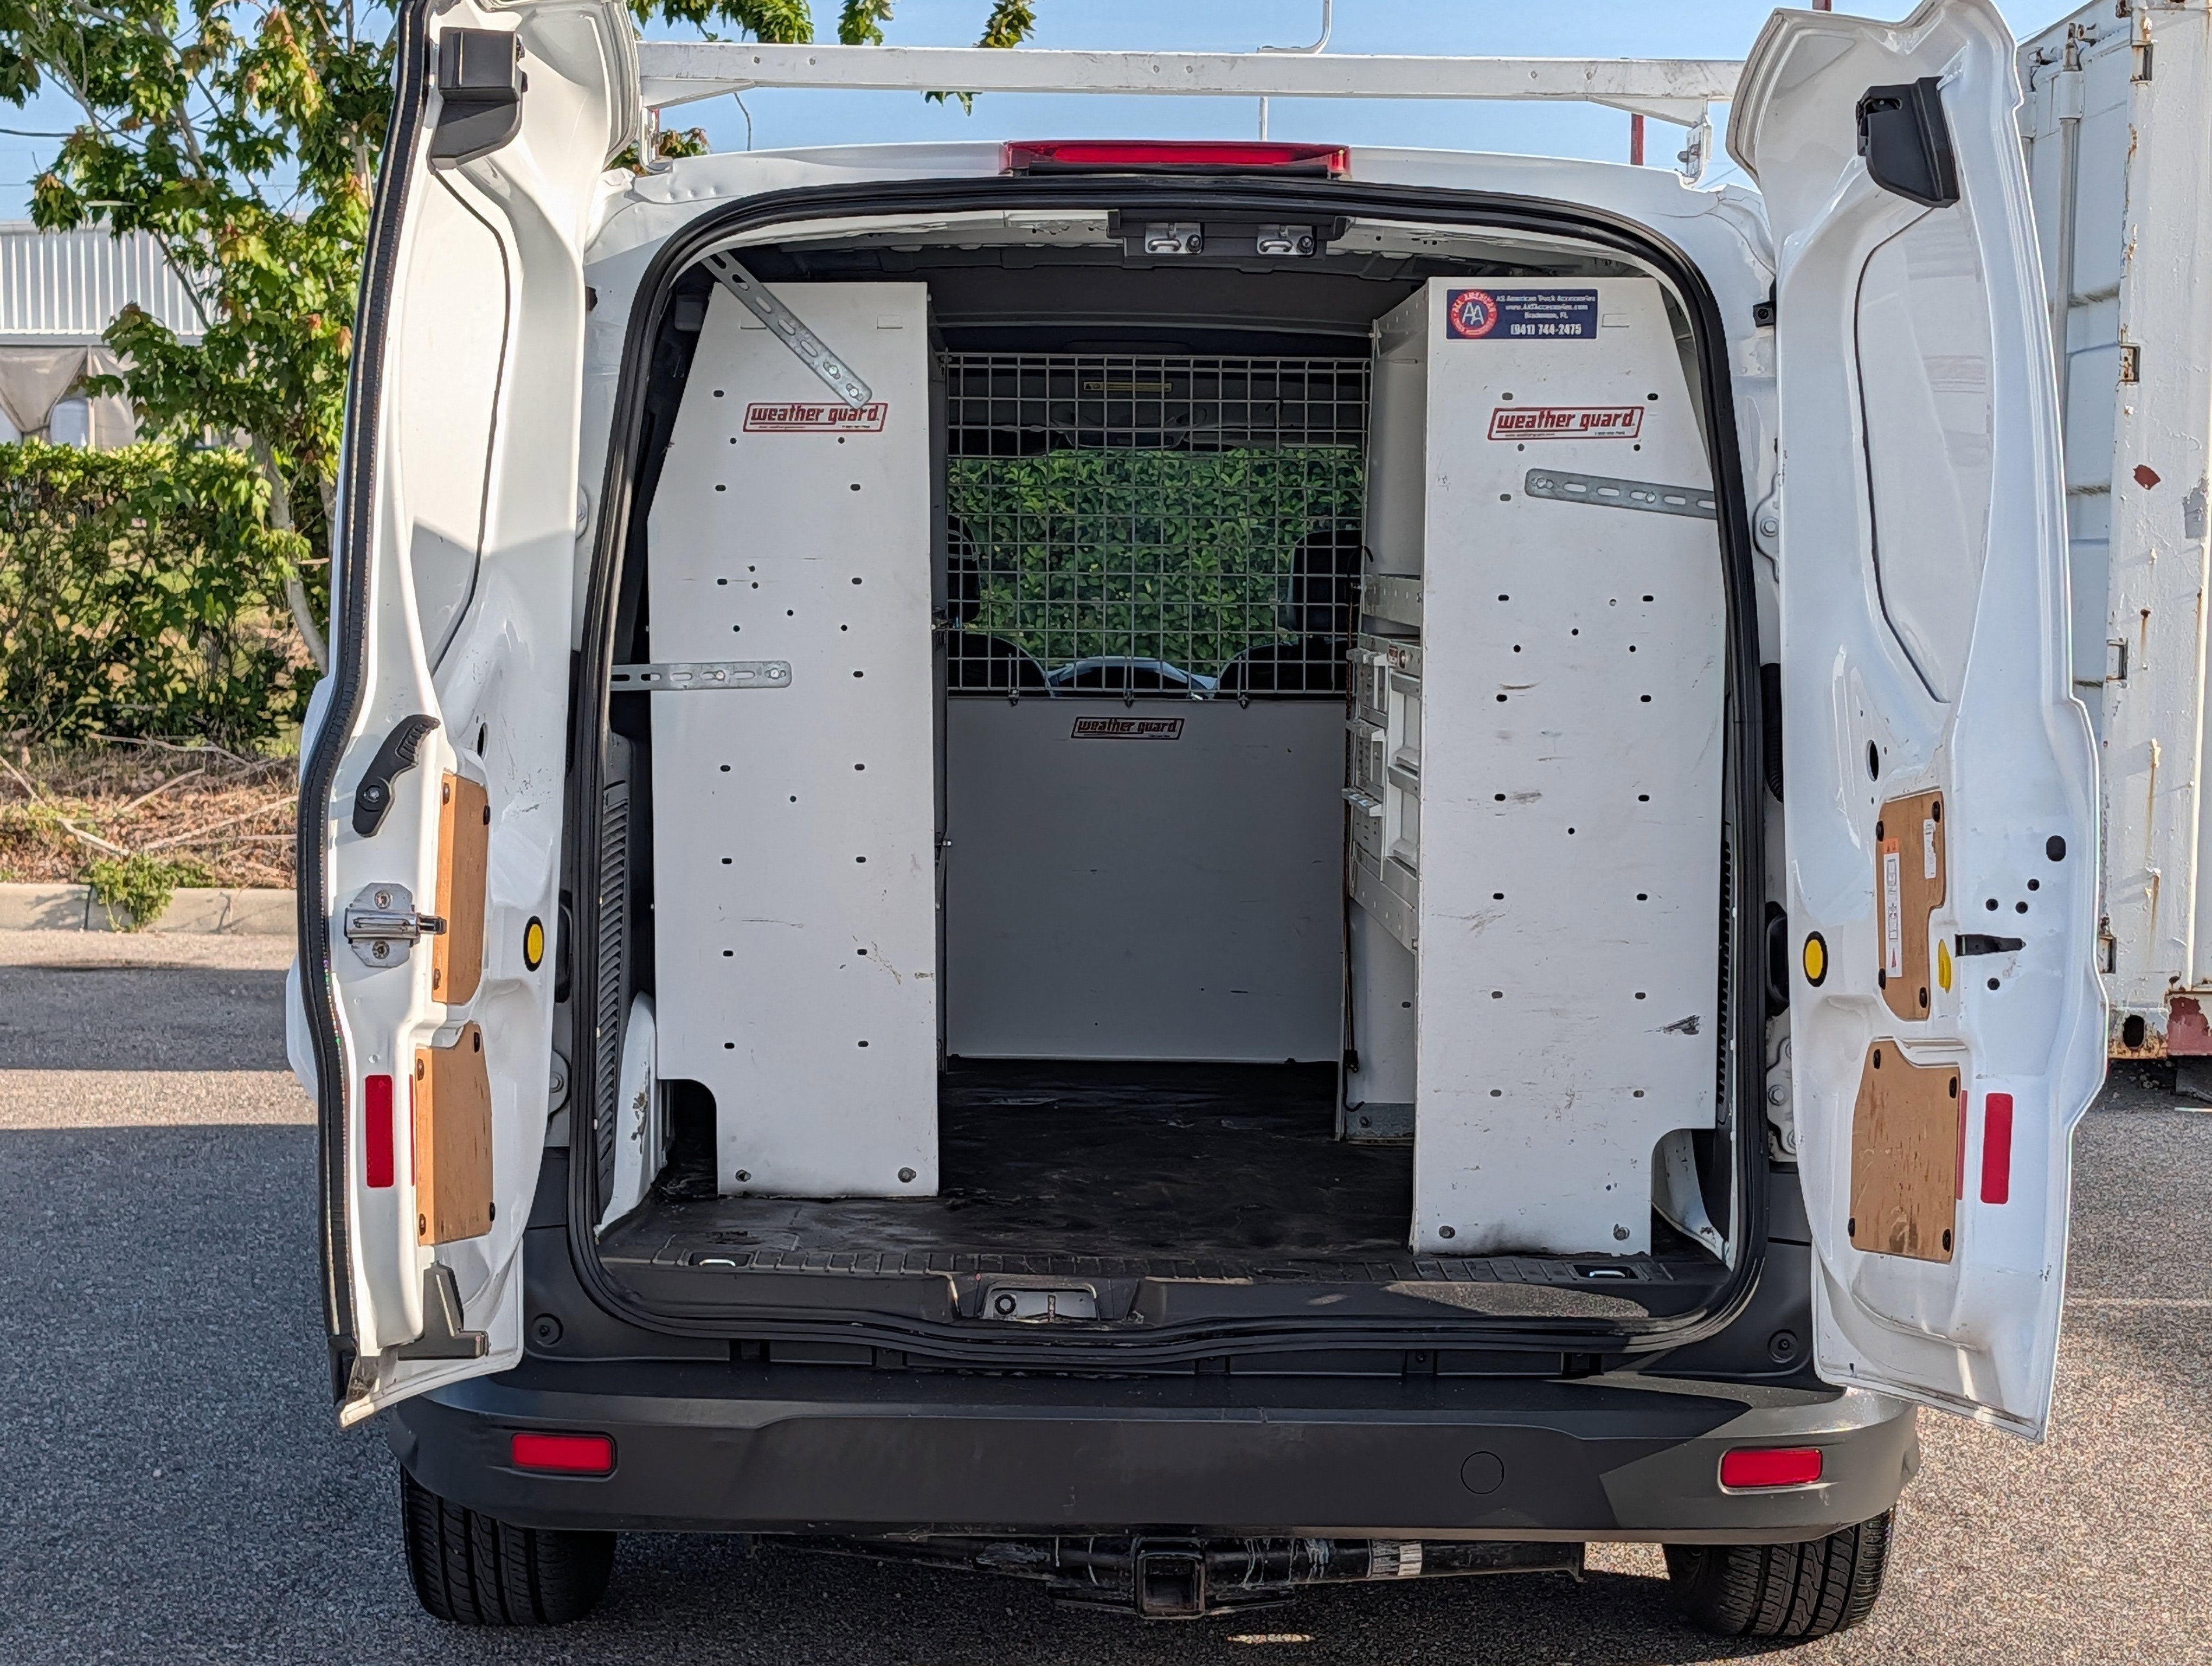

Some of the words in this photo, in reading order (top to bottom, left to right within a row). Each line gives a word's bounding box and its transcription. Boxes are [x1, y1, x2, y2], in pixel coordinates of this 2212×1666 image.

[751, 404, 824, 421] weather
[828, 405, 879, 424] guard
[1497, 409, 1575, 428] weather
[1580, 408, 1634, 431] guard
[1078, 719, 1135, 732] weather
[1138, 719, 1177, 734] guard
